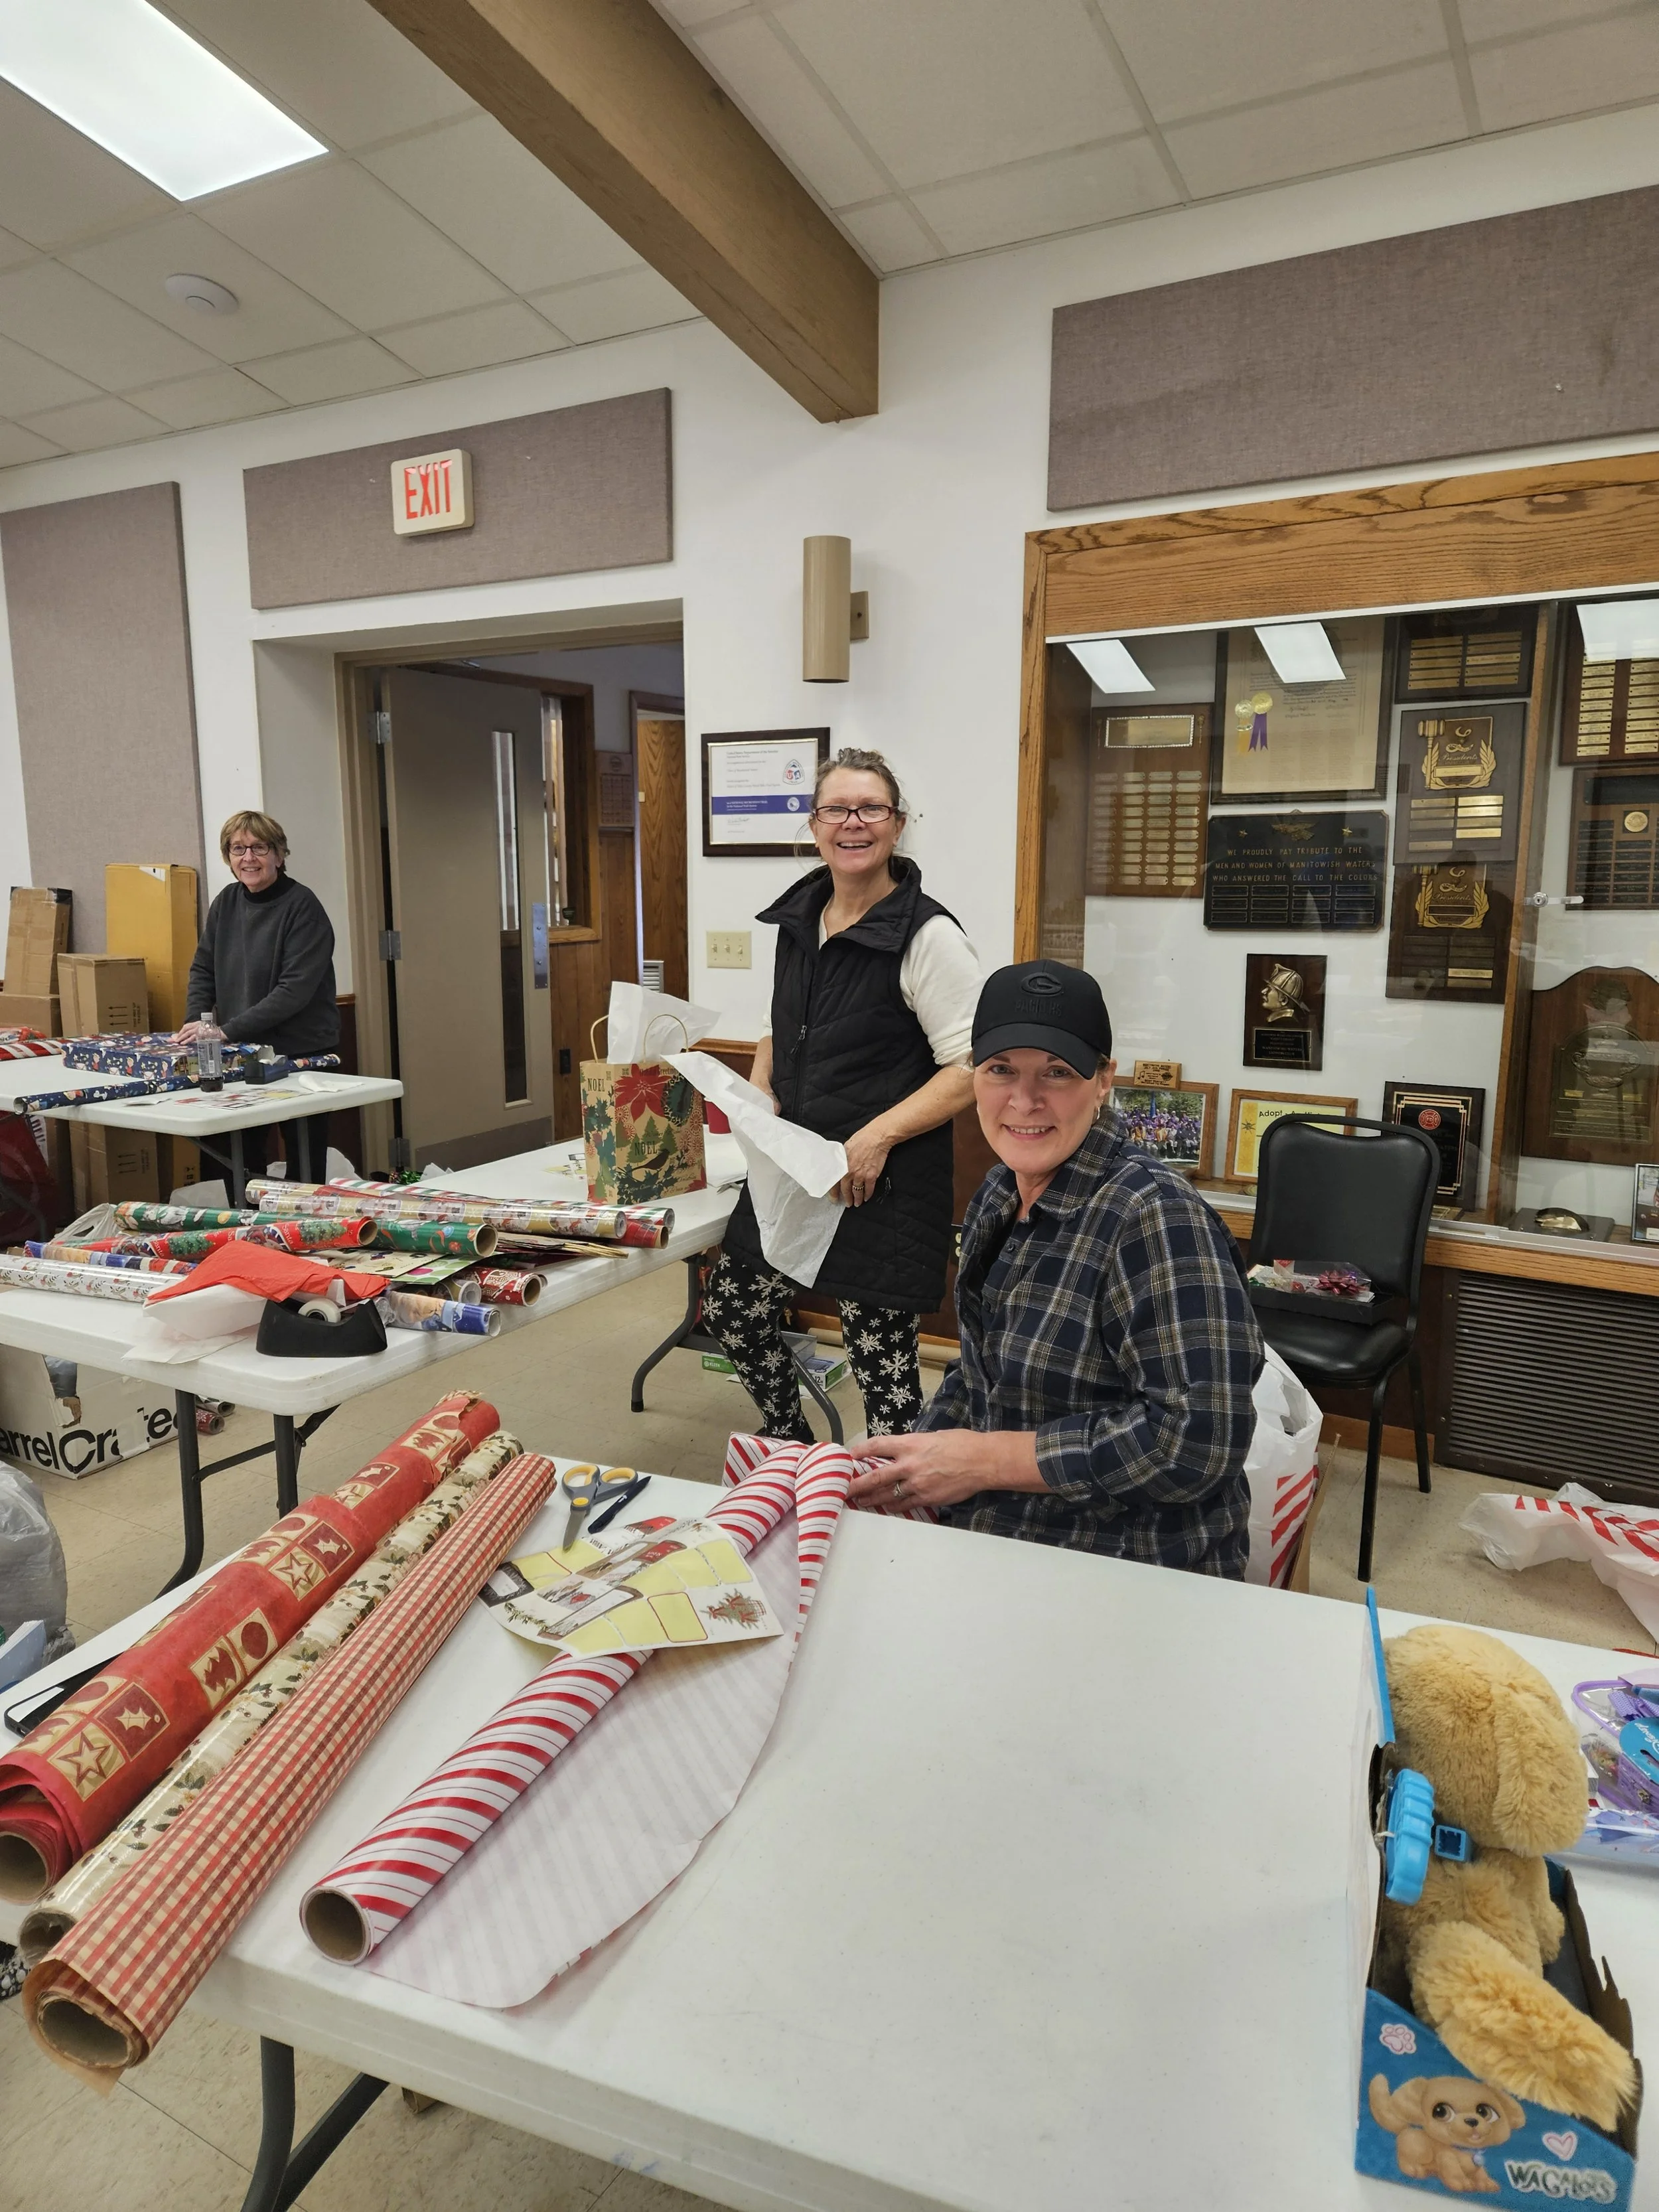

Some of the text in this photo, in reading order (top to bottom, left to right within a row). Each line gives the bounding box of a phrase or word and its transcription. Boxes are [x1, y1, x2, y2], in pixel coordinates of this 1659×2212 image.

[403, 459, 453, 520] EXIT
[1259, 1110, 1283, 1118] Adopt
[634, 1141, 658, 1155] NOEL
